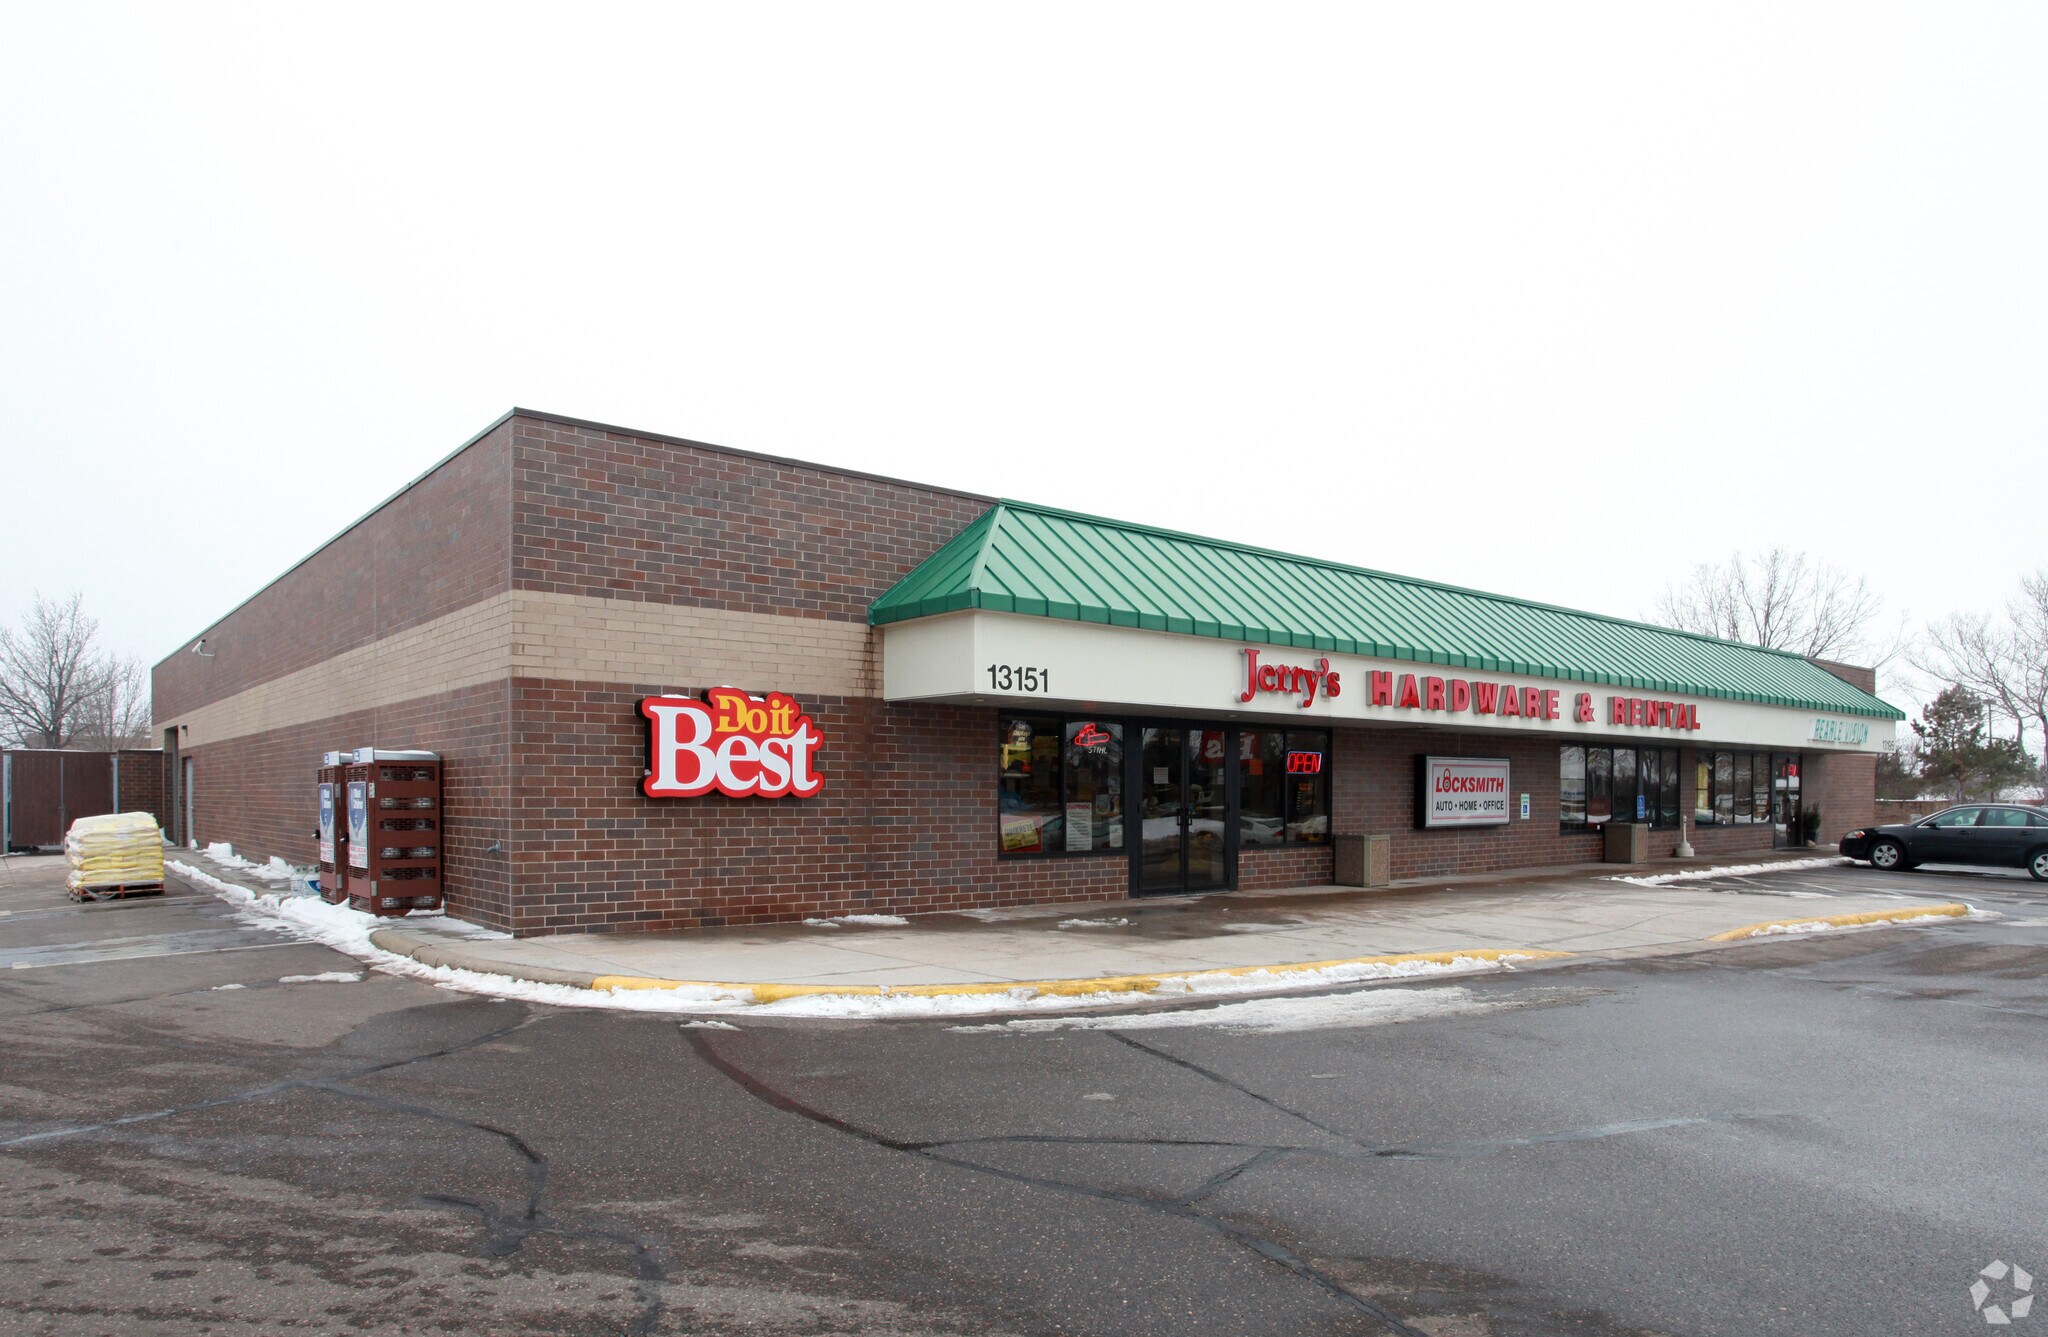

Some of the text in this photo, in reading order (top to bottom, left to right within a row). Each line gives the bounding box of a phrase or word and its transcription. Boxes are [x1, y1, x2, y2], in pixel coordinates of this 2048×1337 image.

[987, 664, 1048, 693] 13151
[1240, 648, 1700, 730] Jerry's HARDWARE & RENTAL
[715, 695, 794, 735] Do it
[649, 706, 819, 792] Best
[1088, 747, 1108, 755] STIHL
[1288, 753, 1321, 773] OPEN
[1435, 768, 1505, 793] LOCKSMITH
[1436, 800, 1504, 811] AUTO HOME OFFICE
